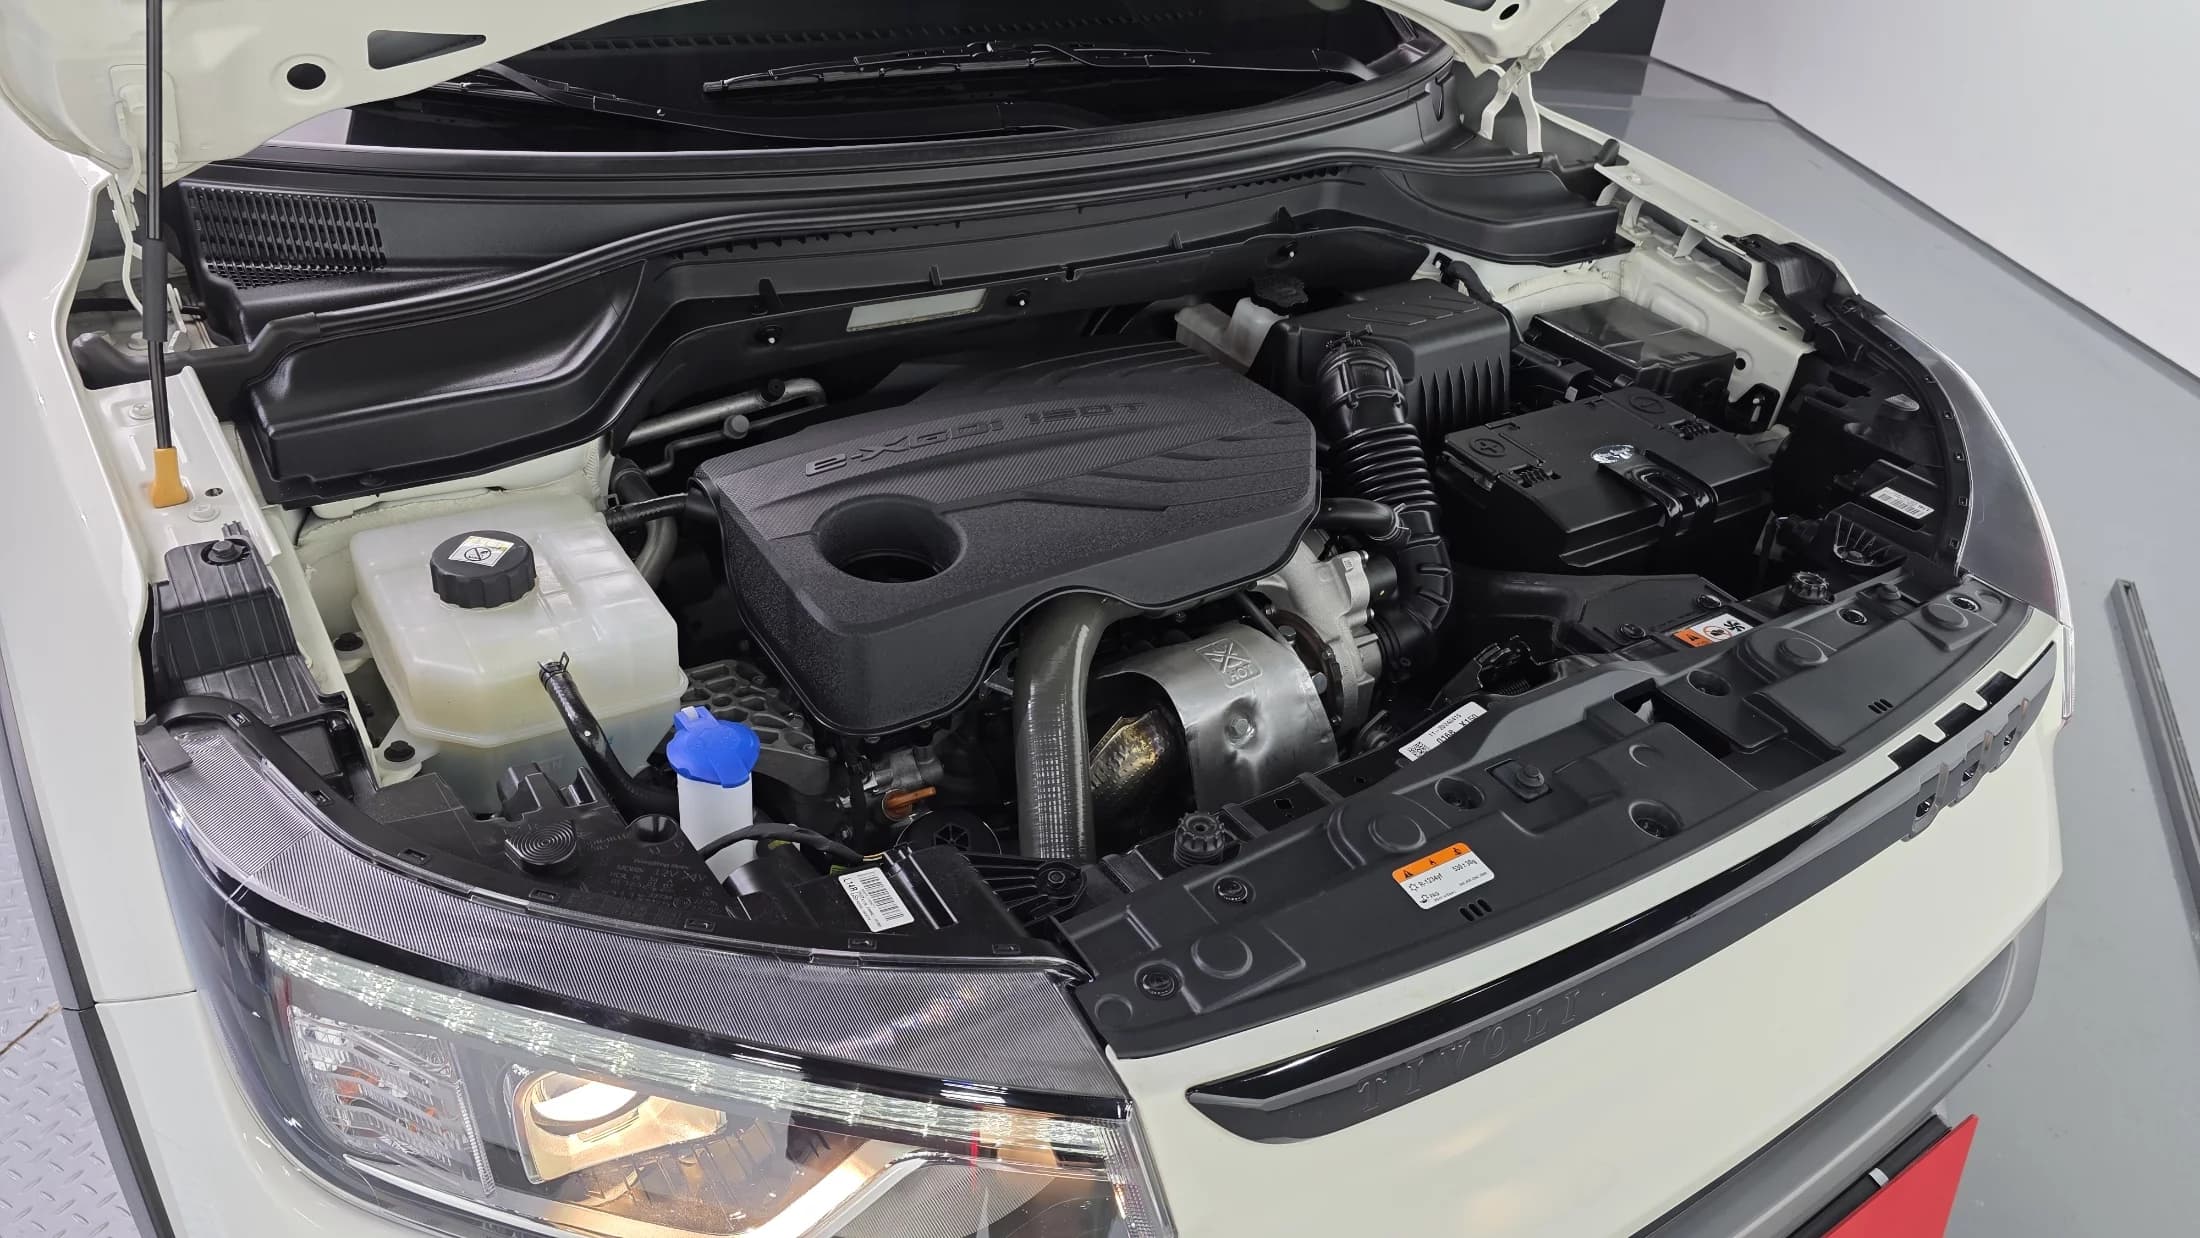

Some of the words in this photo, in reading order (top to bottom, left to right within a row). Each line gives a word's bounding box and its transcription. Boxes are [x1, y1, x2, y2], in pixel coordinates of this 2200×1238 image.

[1023, 401, 1145, 426] 150T
[1230, 663, 1254, 682] HOT
[1356, 988, 1582, 1112] TIVOLI
